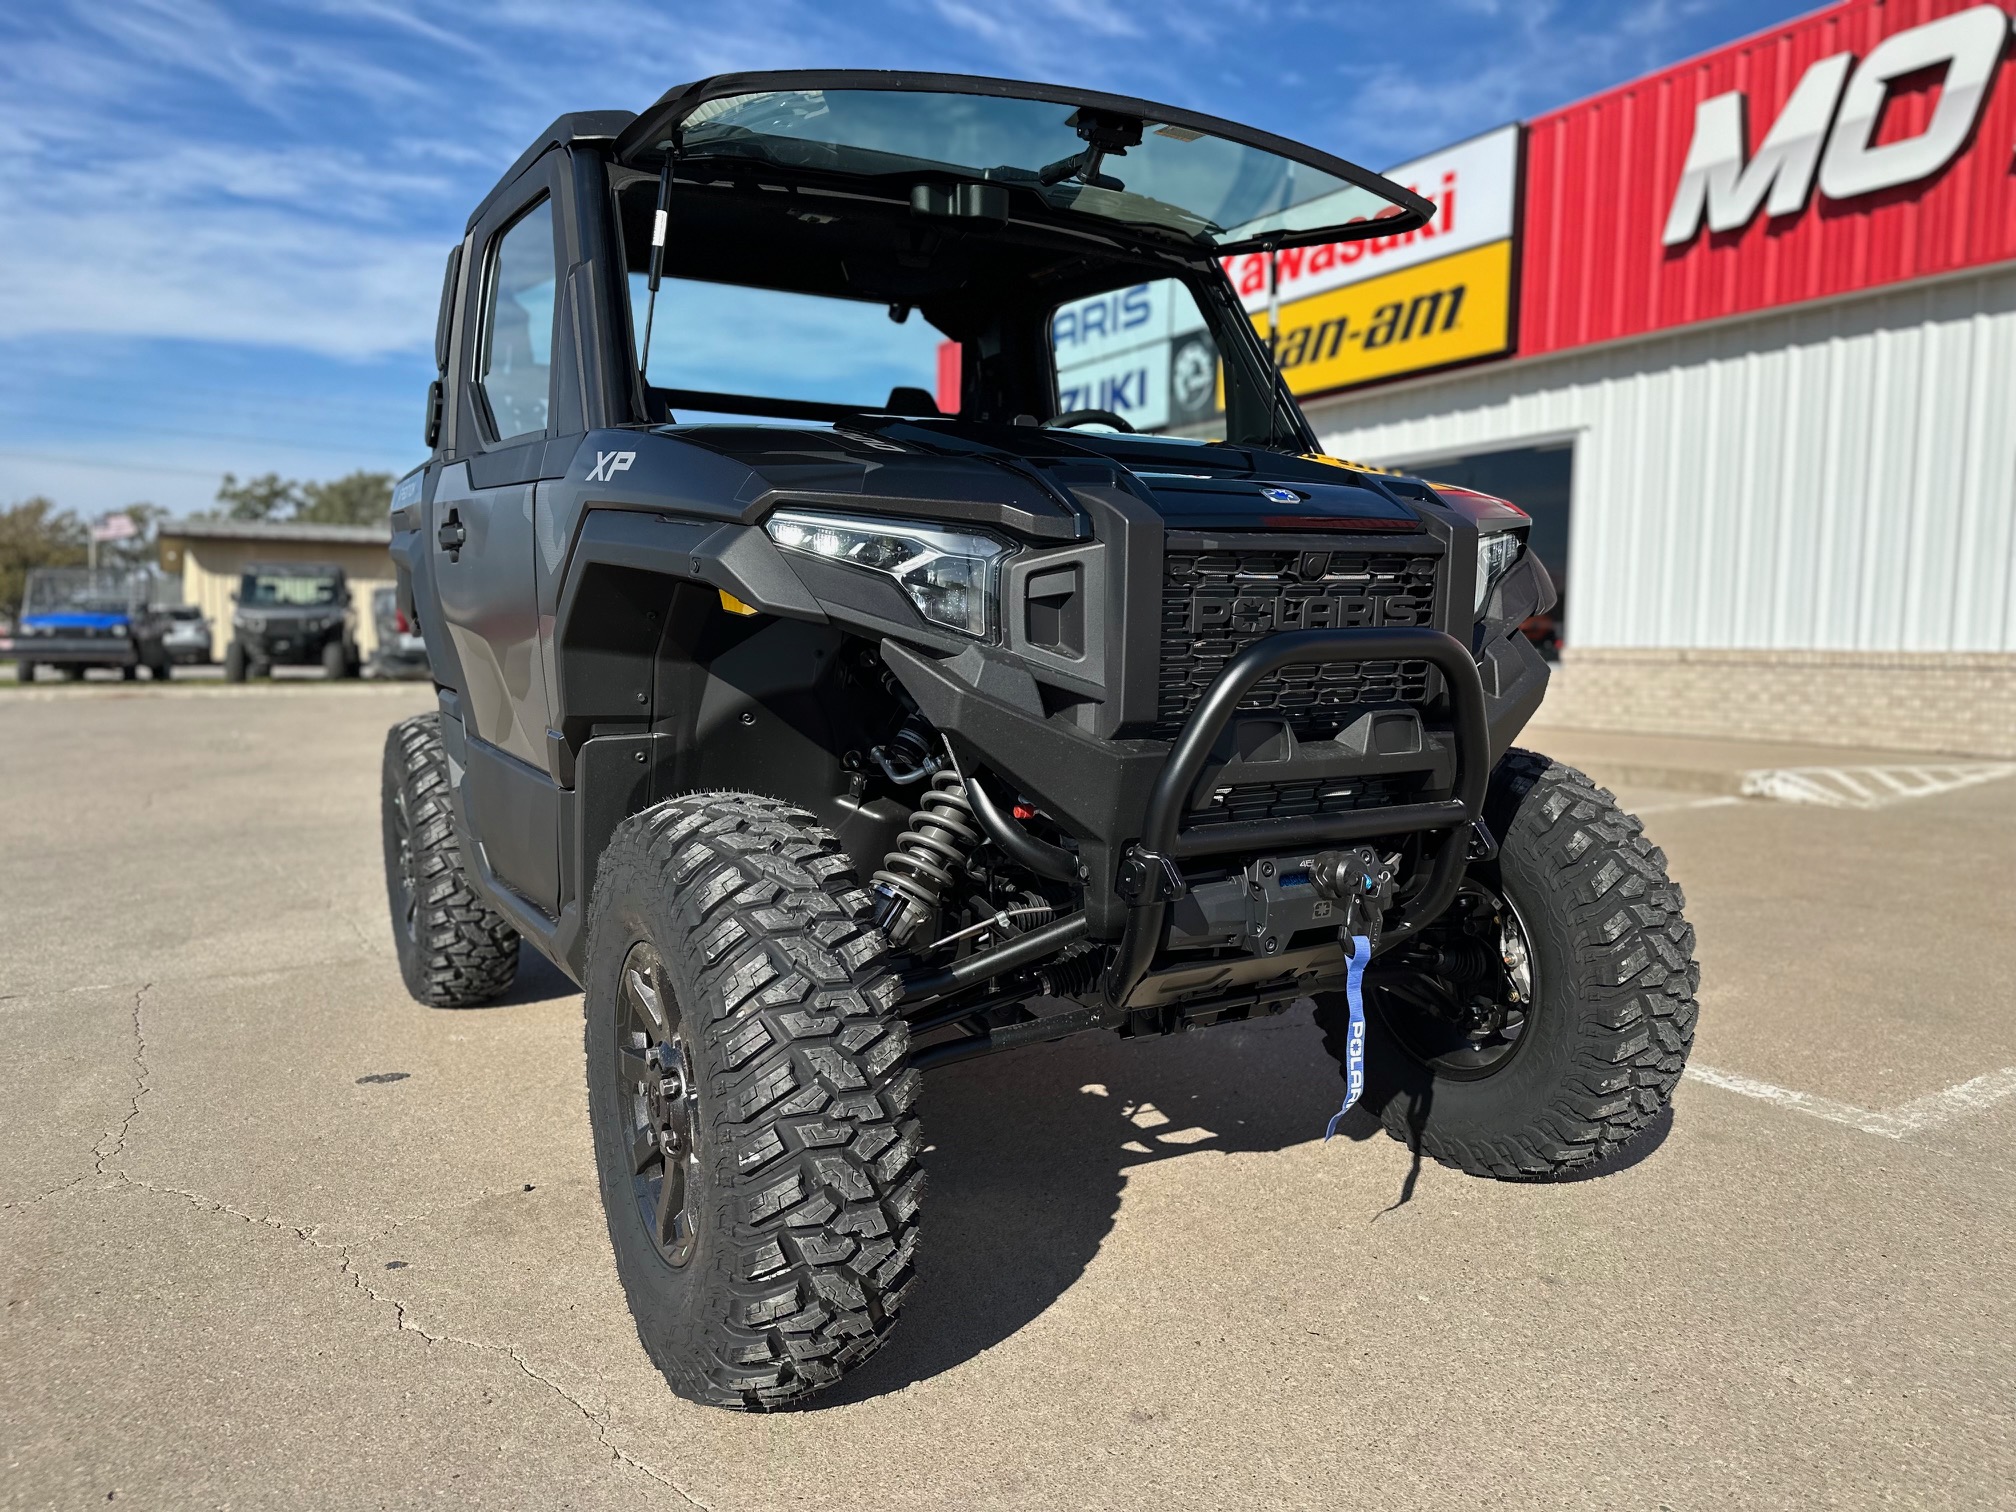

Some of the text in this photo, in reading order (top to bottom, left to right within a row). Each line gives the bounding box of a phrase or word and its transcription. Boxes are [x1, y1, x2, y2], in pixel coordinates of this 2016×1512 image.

[1662, 3, 2016, 246] MO
[1219, 170, 1458, 296] awasai
[1262, 284, 1466, 370] an-am
[585, 451, 636, 482] XP
[1190, 595, 1419, 634] POLARIS
[1299, 859, 1315, 869] 45
